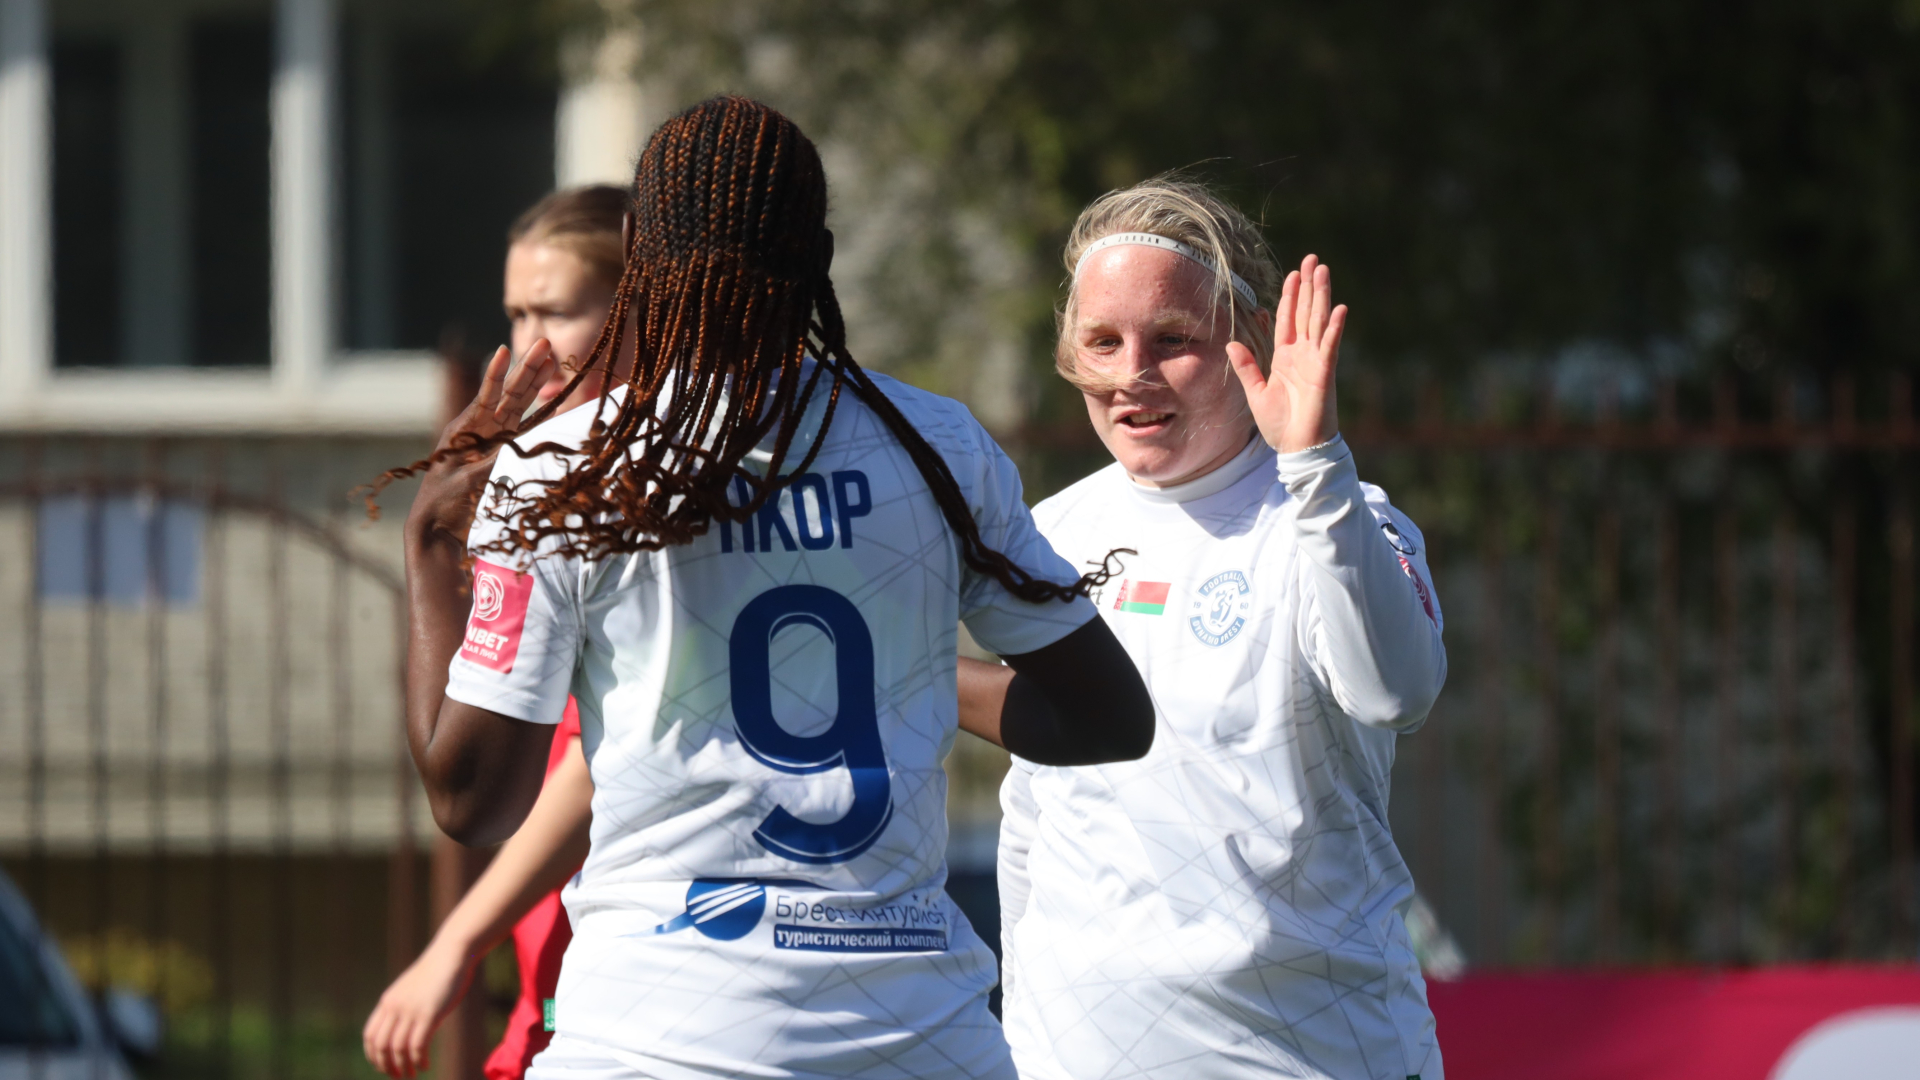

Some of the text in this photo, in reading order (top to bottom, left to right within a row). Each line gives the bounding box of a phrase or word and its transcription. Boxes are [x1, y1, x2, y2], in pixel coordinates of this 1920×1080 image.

[1192, 620, 1219, 646] DYNAMO
[729, 584, 894, 865] 9
[776, 929, 891, 948] туристический
